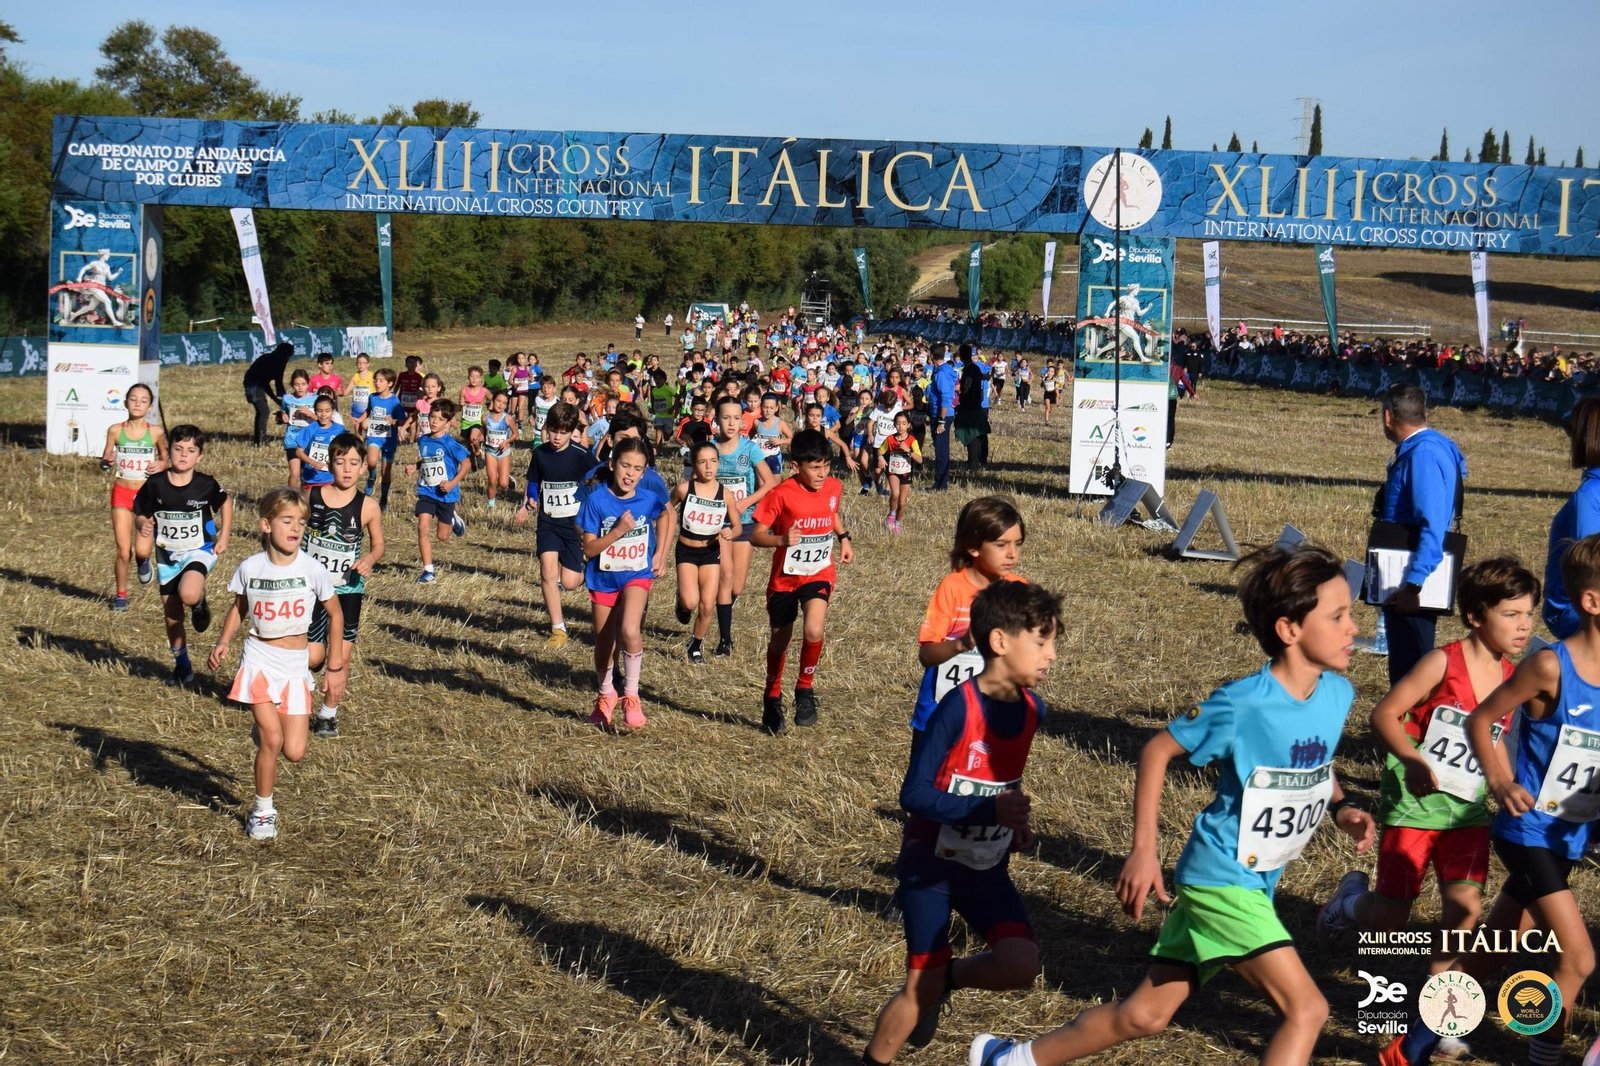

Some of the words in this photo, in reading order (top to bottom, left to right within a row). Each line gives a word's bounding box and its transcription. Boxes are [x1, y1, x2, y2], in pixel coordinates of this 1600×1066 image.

[67, 143, 173, 160] CAMPEONATO
[175, 147, 195, 160] DE
[196, 147, 286, 162] ANDALUCÍA
[101, 158, 122, 171] DE
[124, 159, 179, 173] CAMPO
[181, 161, 194, 173] A
[195, 159, 252, 175] TRAVÉS
[346, 138, 503, 193] XLIII
[507, 143, 631, 176] CROSS
[686, 137, 988, 213] ITÁLICA
[135, 172, 165, 186] POR
[168, 174, 222, 187] CLUBES
[507, 177, 675, 198] INTERNACIONAL
[1205, 164, 1368, 222] XLIII
[1372, 172, 1498, 208] CROSS
[346, 193, 493, 213] INTERNATIONAL
[497, 198, 553, 215] CROSS
[556, 199, 644, 217] COUNTRY
[98, 219, 131, 230] Sevilla
[1371, 206, 1542, 230] INTERNACIONAL
[1204, 220, 1355, 242] INTERNATIONAL
[1360, 226, 1417, 244] CROSS
[1421, 231, 1511, 249] COUNTRY
[1128, 253, 1162, 264] Sevilla
[422, 466, 444, 478] 4170
[687, 510, 723, 526] 4413
[160, 524, 200, 540] 4259
[606, 542, 646, 560] 4409
[790, 546, 830, 563] 4126
[253, 598, 306, 622] 4546
[1252, 798, 1325, 839] 4300
